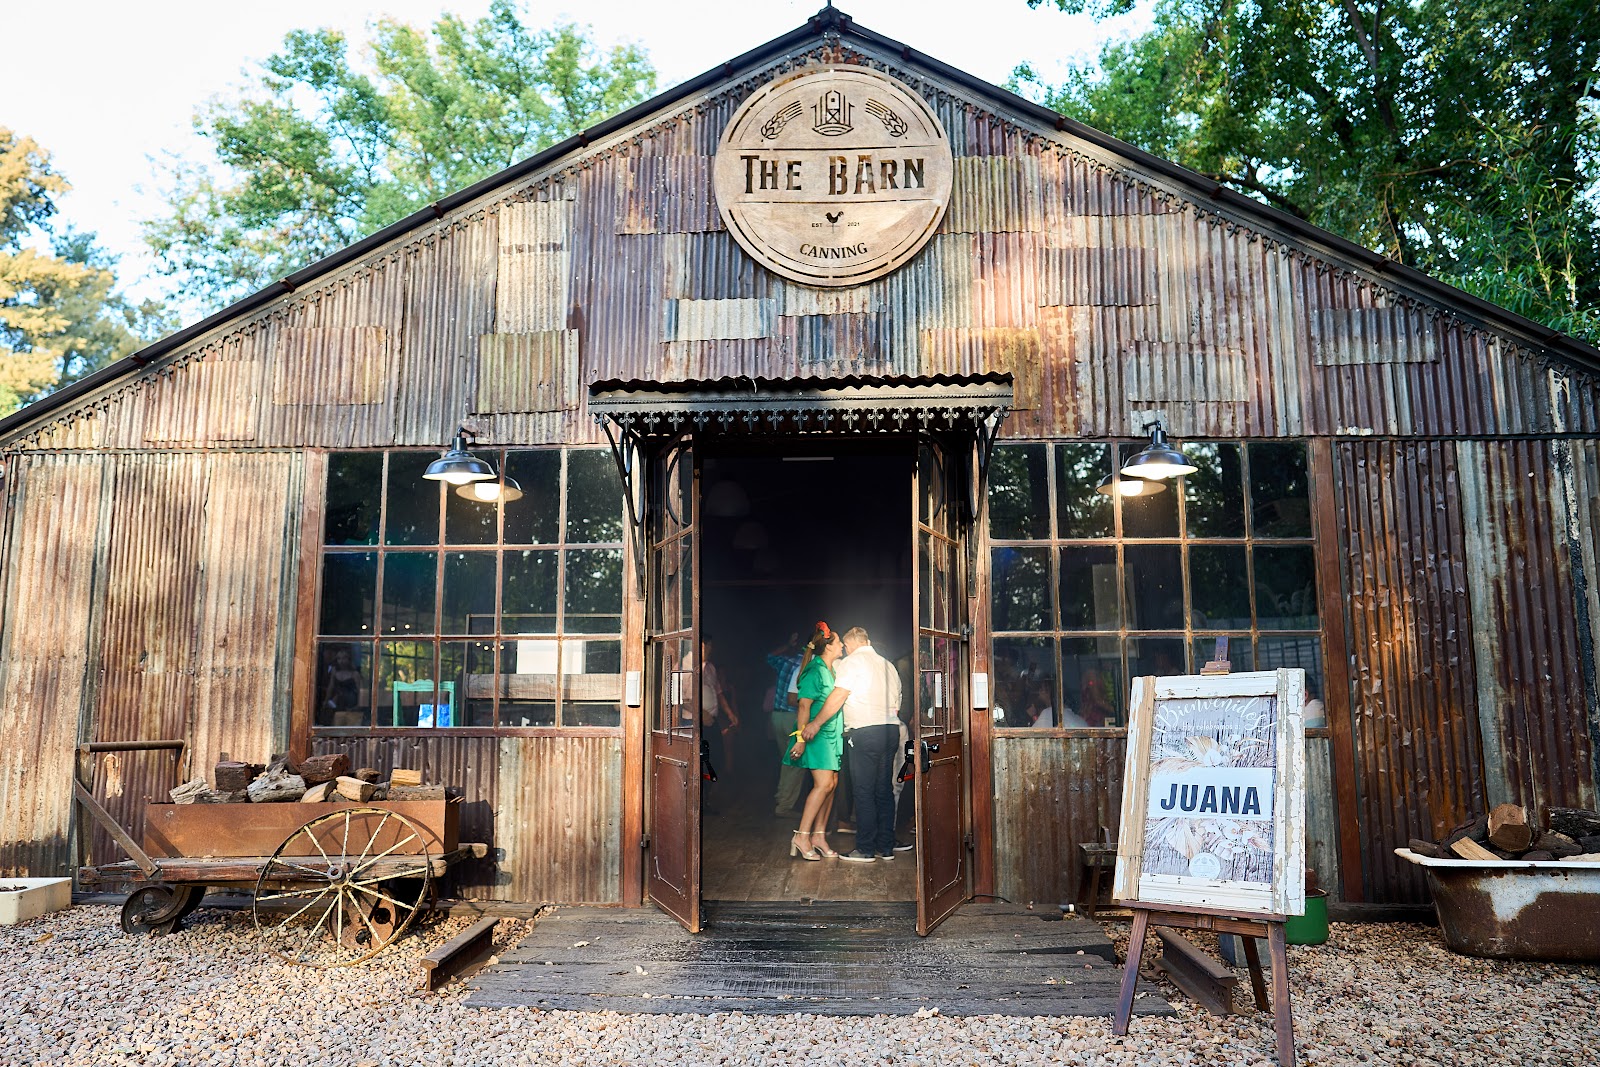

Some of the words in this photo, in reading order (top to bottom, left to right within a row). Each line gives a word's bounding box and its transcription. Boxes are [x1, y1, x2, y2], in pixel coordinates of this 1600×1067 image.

[740, 154, 802, 194] THE
[828, 154, 925, 196] BARN
[799, 242, 868, 259] CANNING
[1155, 697, 1270, 732] Bienvenidos
[1160, 783, 1262, 815] JUANA
